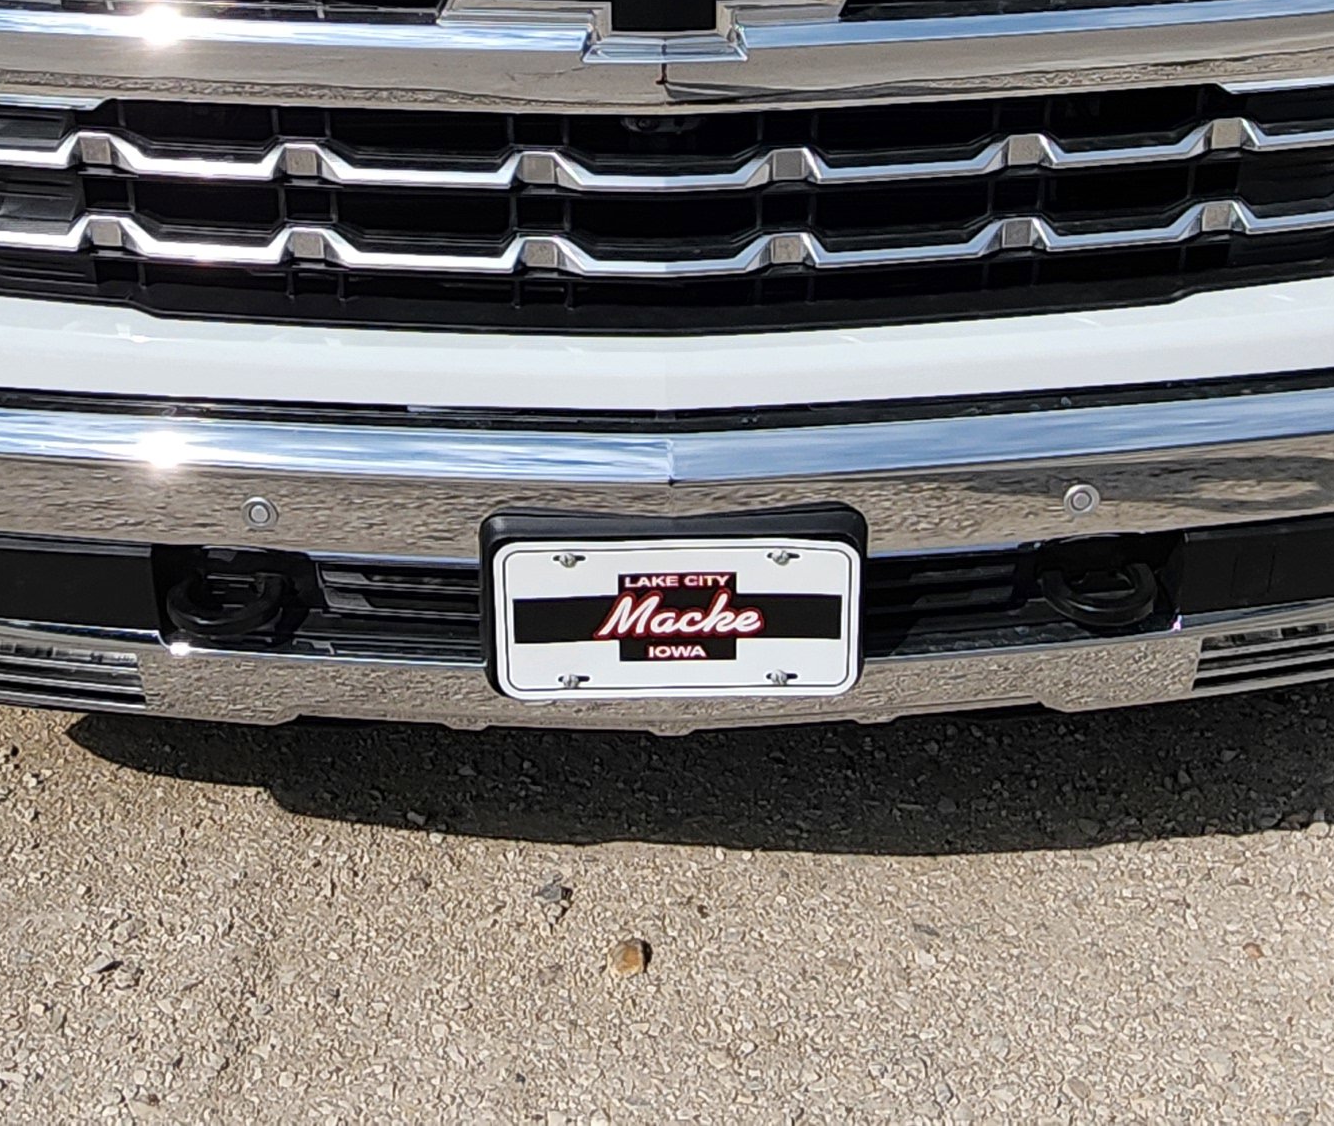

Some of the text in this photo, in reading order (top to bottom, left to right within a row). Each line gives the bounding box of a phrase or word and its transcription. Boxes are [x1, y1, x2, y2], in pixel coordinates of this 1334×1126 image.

[624, 574, 731, 588] LAKE CITY
[596, 591, 763, 638] Macke
[647, 645, 707, 658] IOWA
